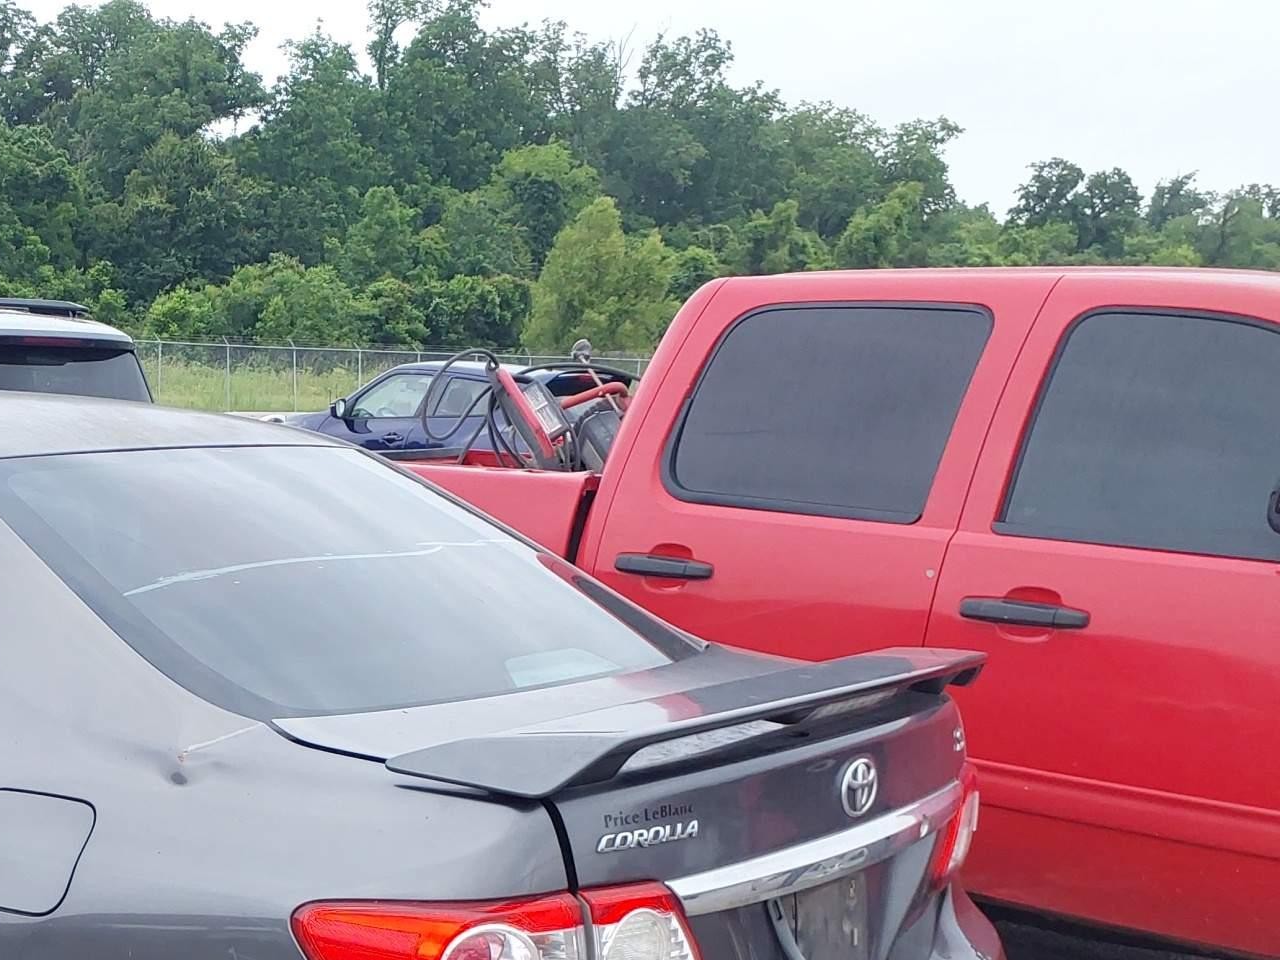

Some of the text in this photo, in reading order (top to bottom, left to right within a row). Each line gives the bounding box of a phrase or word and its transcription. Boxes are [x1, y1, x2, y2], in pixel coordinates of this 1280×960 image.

[603, 803, 695, 829] Price LeBlanc
[596, 819, 699, 854] COROLLA
